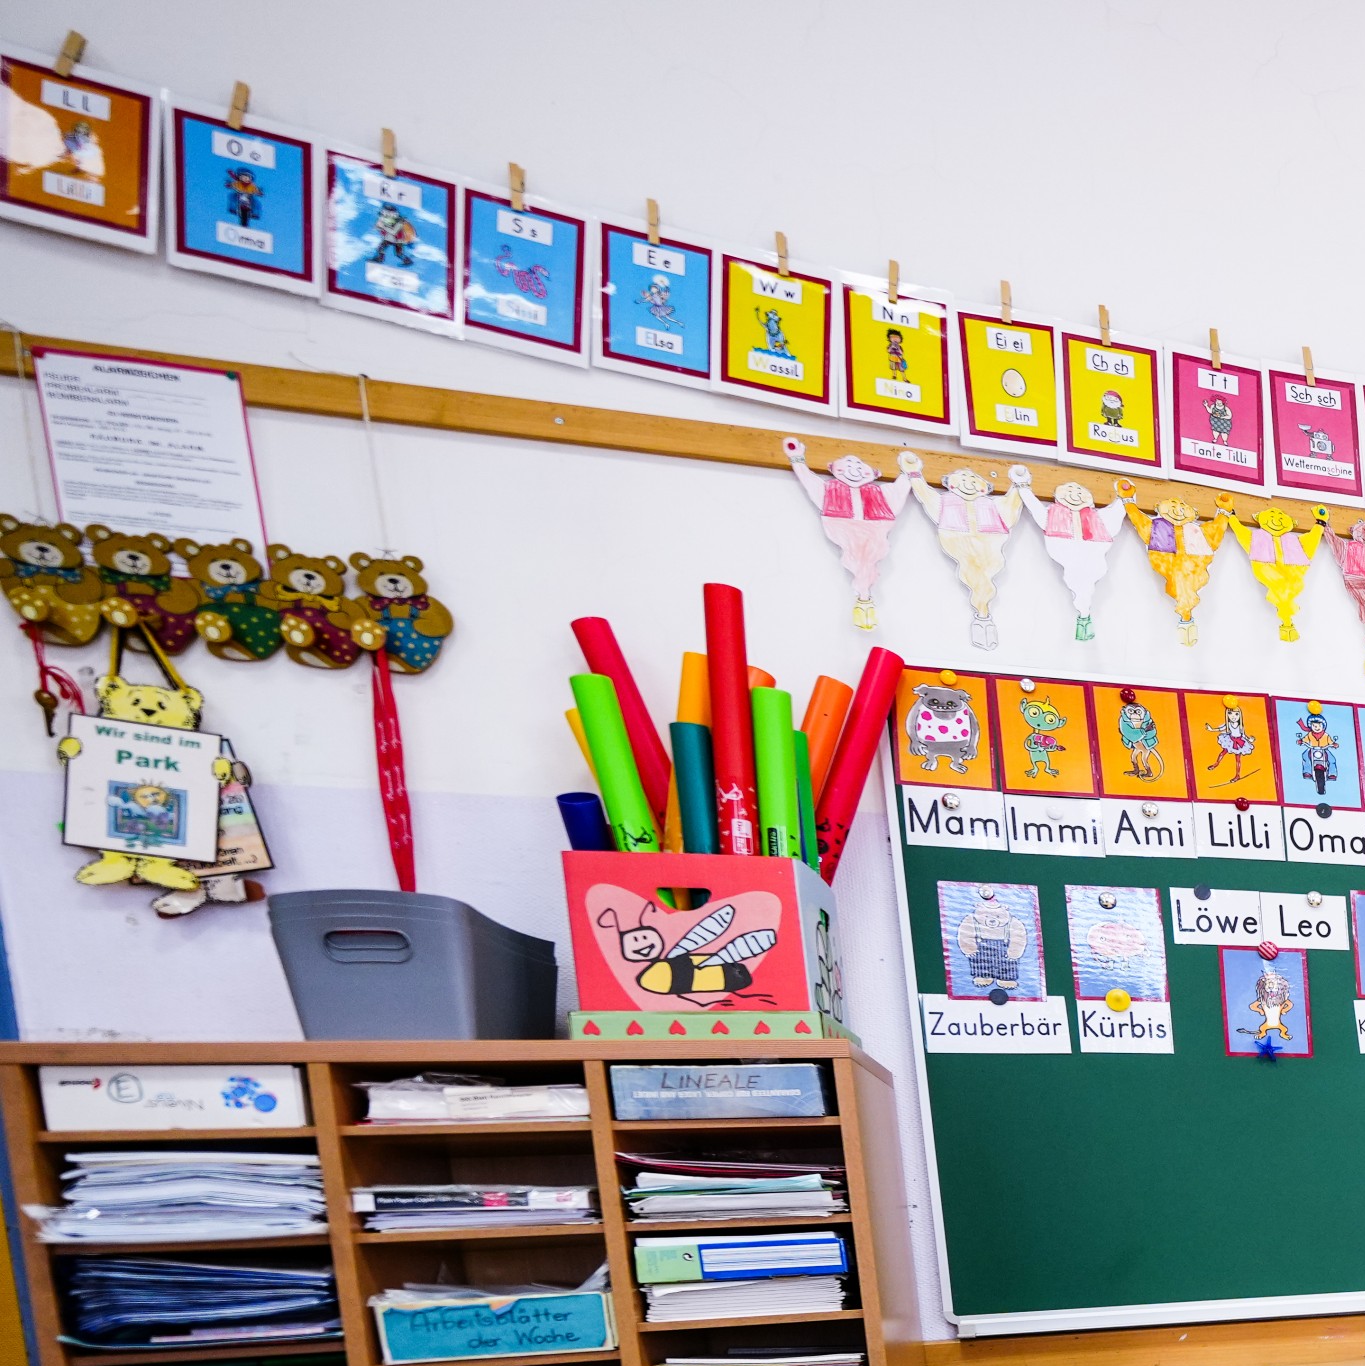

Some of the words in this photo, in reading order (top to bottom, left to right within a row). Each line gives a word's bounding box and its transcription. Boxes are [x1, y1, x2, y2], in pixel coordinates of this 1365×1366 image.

[226, 139, 243, 156] O
[224, 227, 265, 250] Oma
[512, 217, 523, 234] S
[530, 228, 537, 238] s
[648, 249, 657, 266] E
[663, 258, 672, 269] e
[759, 279, 779, 295] W
[784, 289, 796, 300] w
[882, 307, 894, 321] N
[901, 315, 909, 324] n
[645, 332, 674, 351] Elsa
[995, 332, 1007, 348] Ei
[1013, 339, 1023, 350] ei
[753, 354, 799, 379] Wassil
[1092, 354, 1108, 368] Ch
[1114, 359, 1129, 373] ch
[884, 383, 913, 399] Nino
[1208, 374, 1218, 387] T
[1222, 376, 1228, 390] t
[1291, 386, 1312, 402] Sch
[1317, 393, 1337, 406] sch
[1192, 442, 1222, 460] Tante
[1227, 448, 1248, 464] Tilli
[1284, 457, 1352, 477] Wettermaschine
[94, 724, 127, 739] Wir
[133, 729, 174, 745] sind
[179, 737, 202, 749] im
[116, 749, 181, 773] Park
[908, 797, 1001, 837] Mam
[1010, 805, 1099, 845] Immi
[1114, 809, 1185, 847] Ami
[1207, 812, 1271, 849] Lilli
[1176, 899, 1259, 935] Löwe
[1279, 904, 1332, 938] Leo
[928, 1011, 1062, 1038] Zauberbär
[1082, 1010, 1167, 1039] Kürbis
[661, 1073, 761, 1089] LINEALE
[410, 1309, 574, 1333] Arbeitsblätter
[468, 1335, 502, 1348] der
[515, 1326, 581, 1345] Woche
